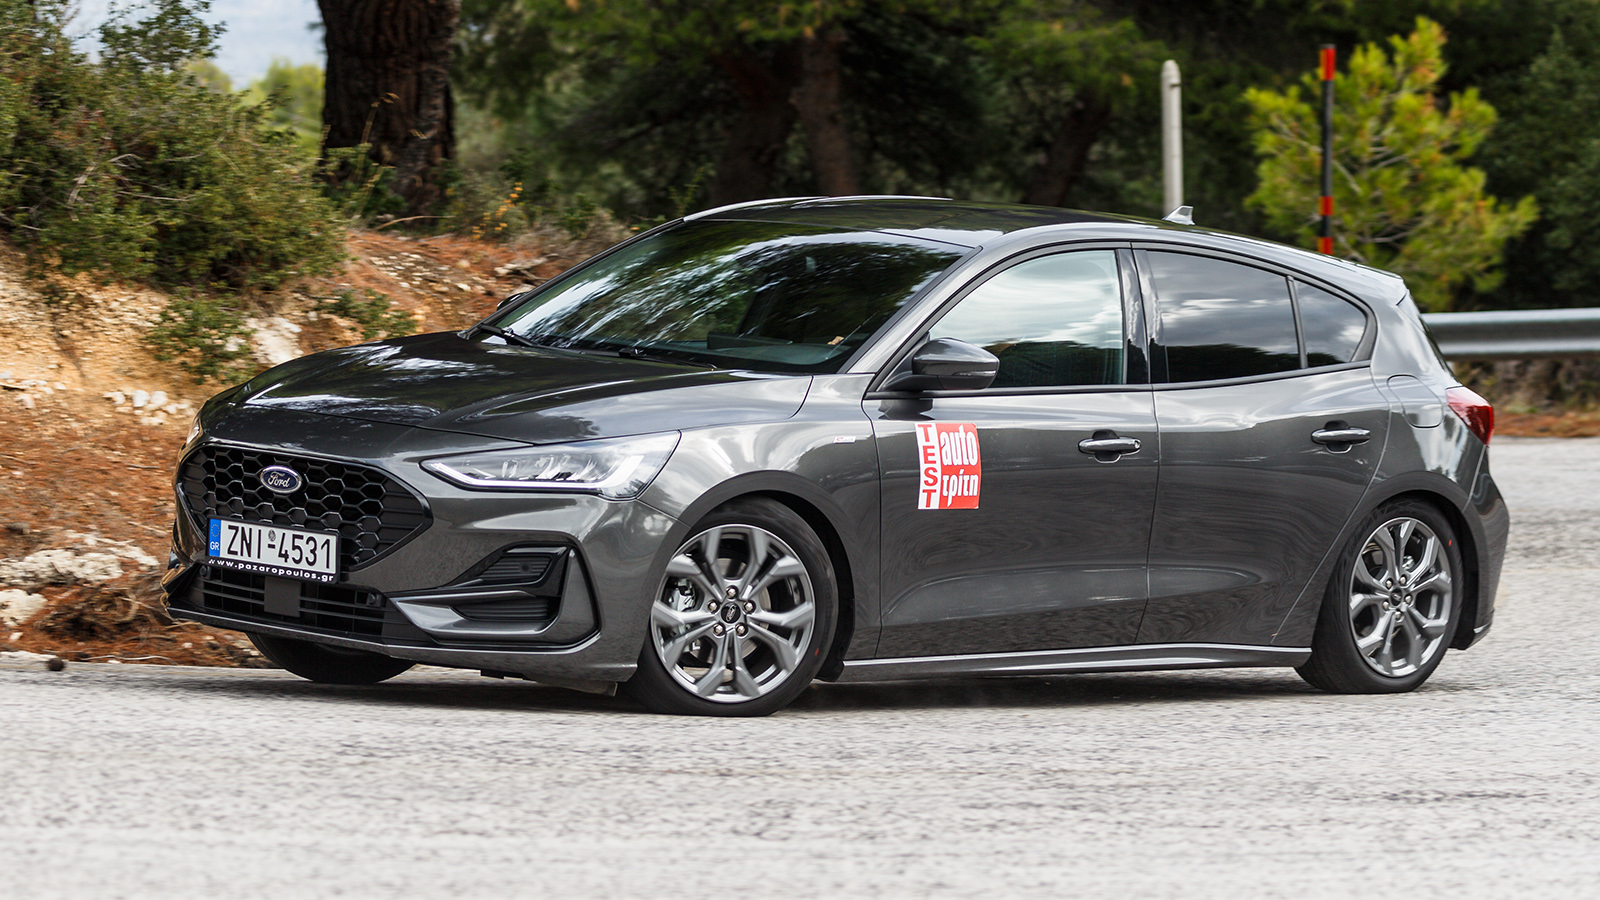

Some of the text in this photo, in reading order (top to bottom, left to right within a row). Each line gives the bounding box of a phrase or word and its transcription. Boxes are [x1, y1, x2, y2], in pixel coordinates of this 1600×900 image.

[917, 424, 939, 508] TEST
[940, 424, 978, 466] auto
[267, 471, 291, 488] Ford
[209, 541, 220, 551] GR
[227, 524, 331, 570] ZNI-4531
